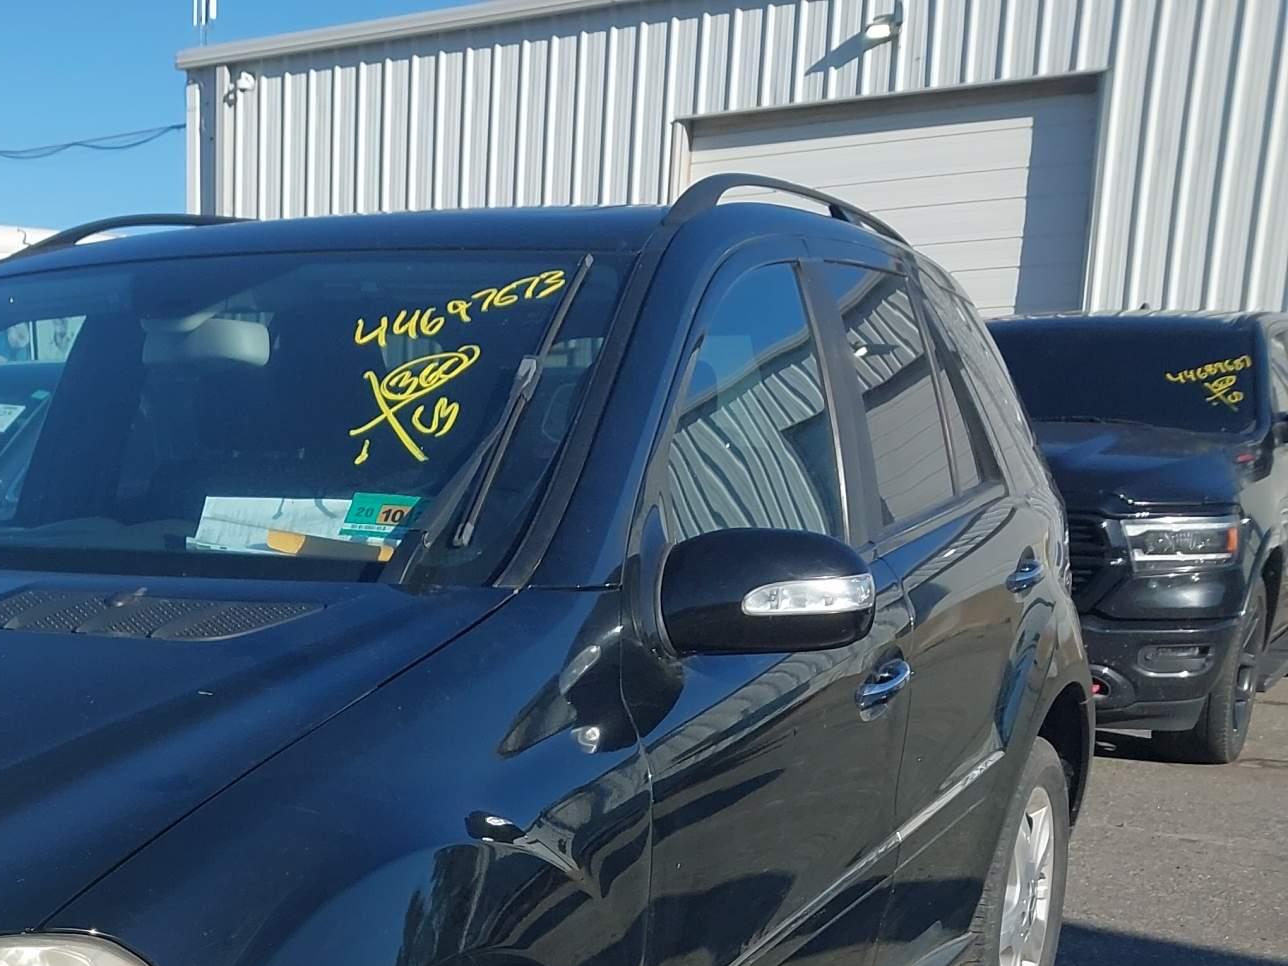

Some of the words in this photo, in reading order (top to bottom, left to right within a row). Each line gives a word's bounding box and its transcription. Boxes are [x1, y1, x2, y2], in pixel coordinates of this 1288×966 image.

[353, 269, 566, 348] 44697673
[388, 356, 465, 397] 360
[355, 506, 375, 518] 20
[381, 508, 404, 523] 10
